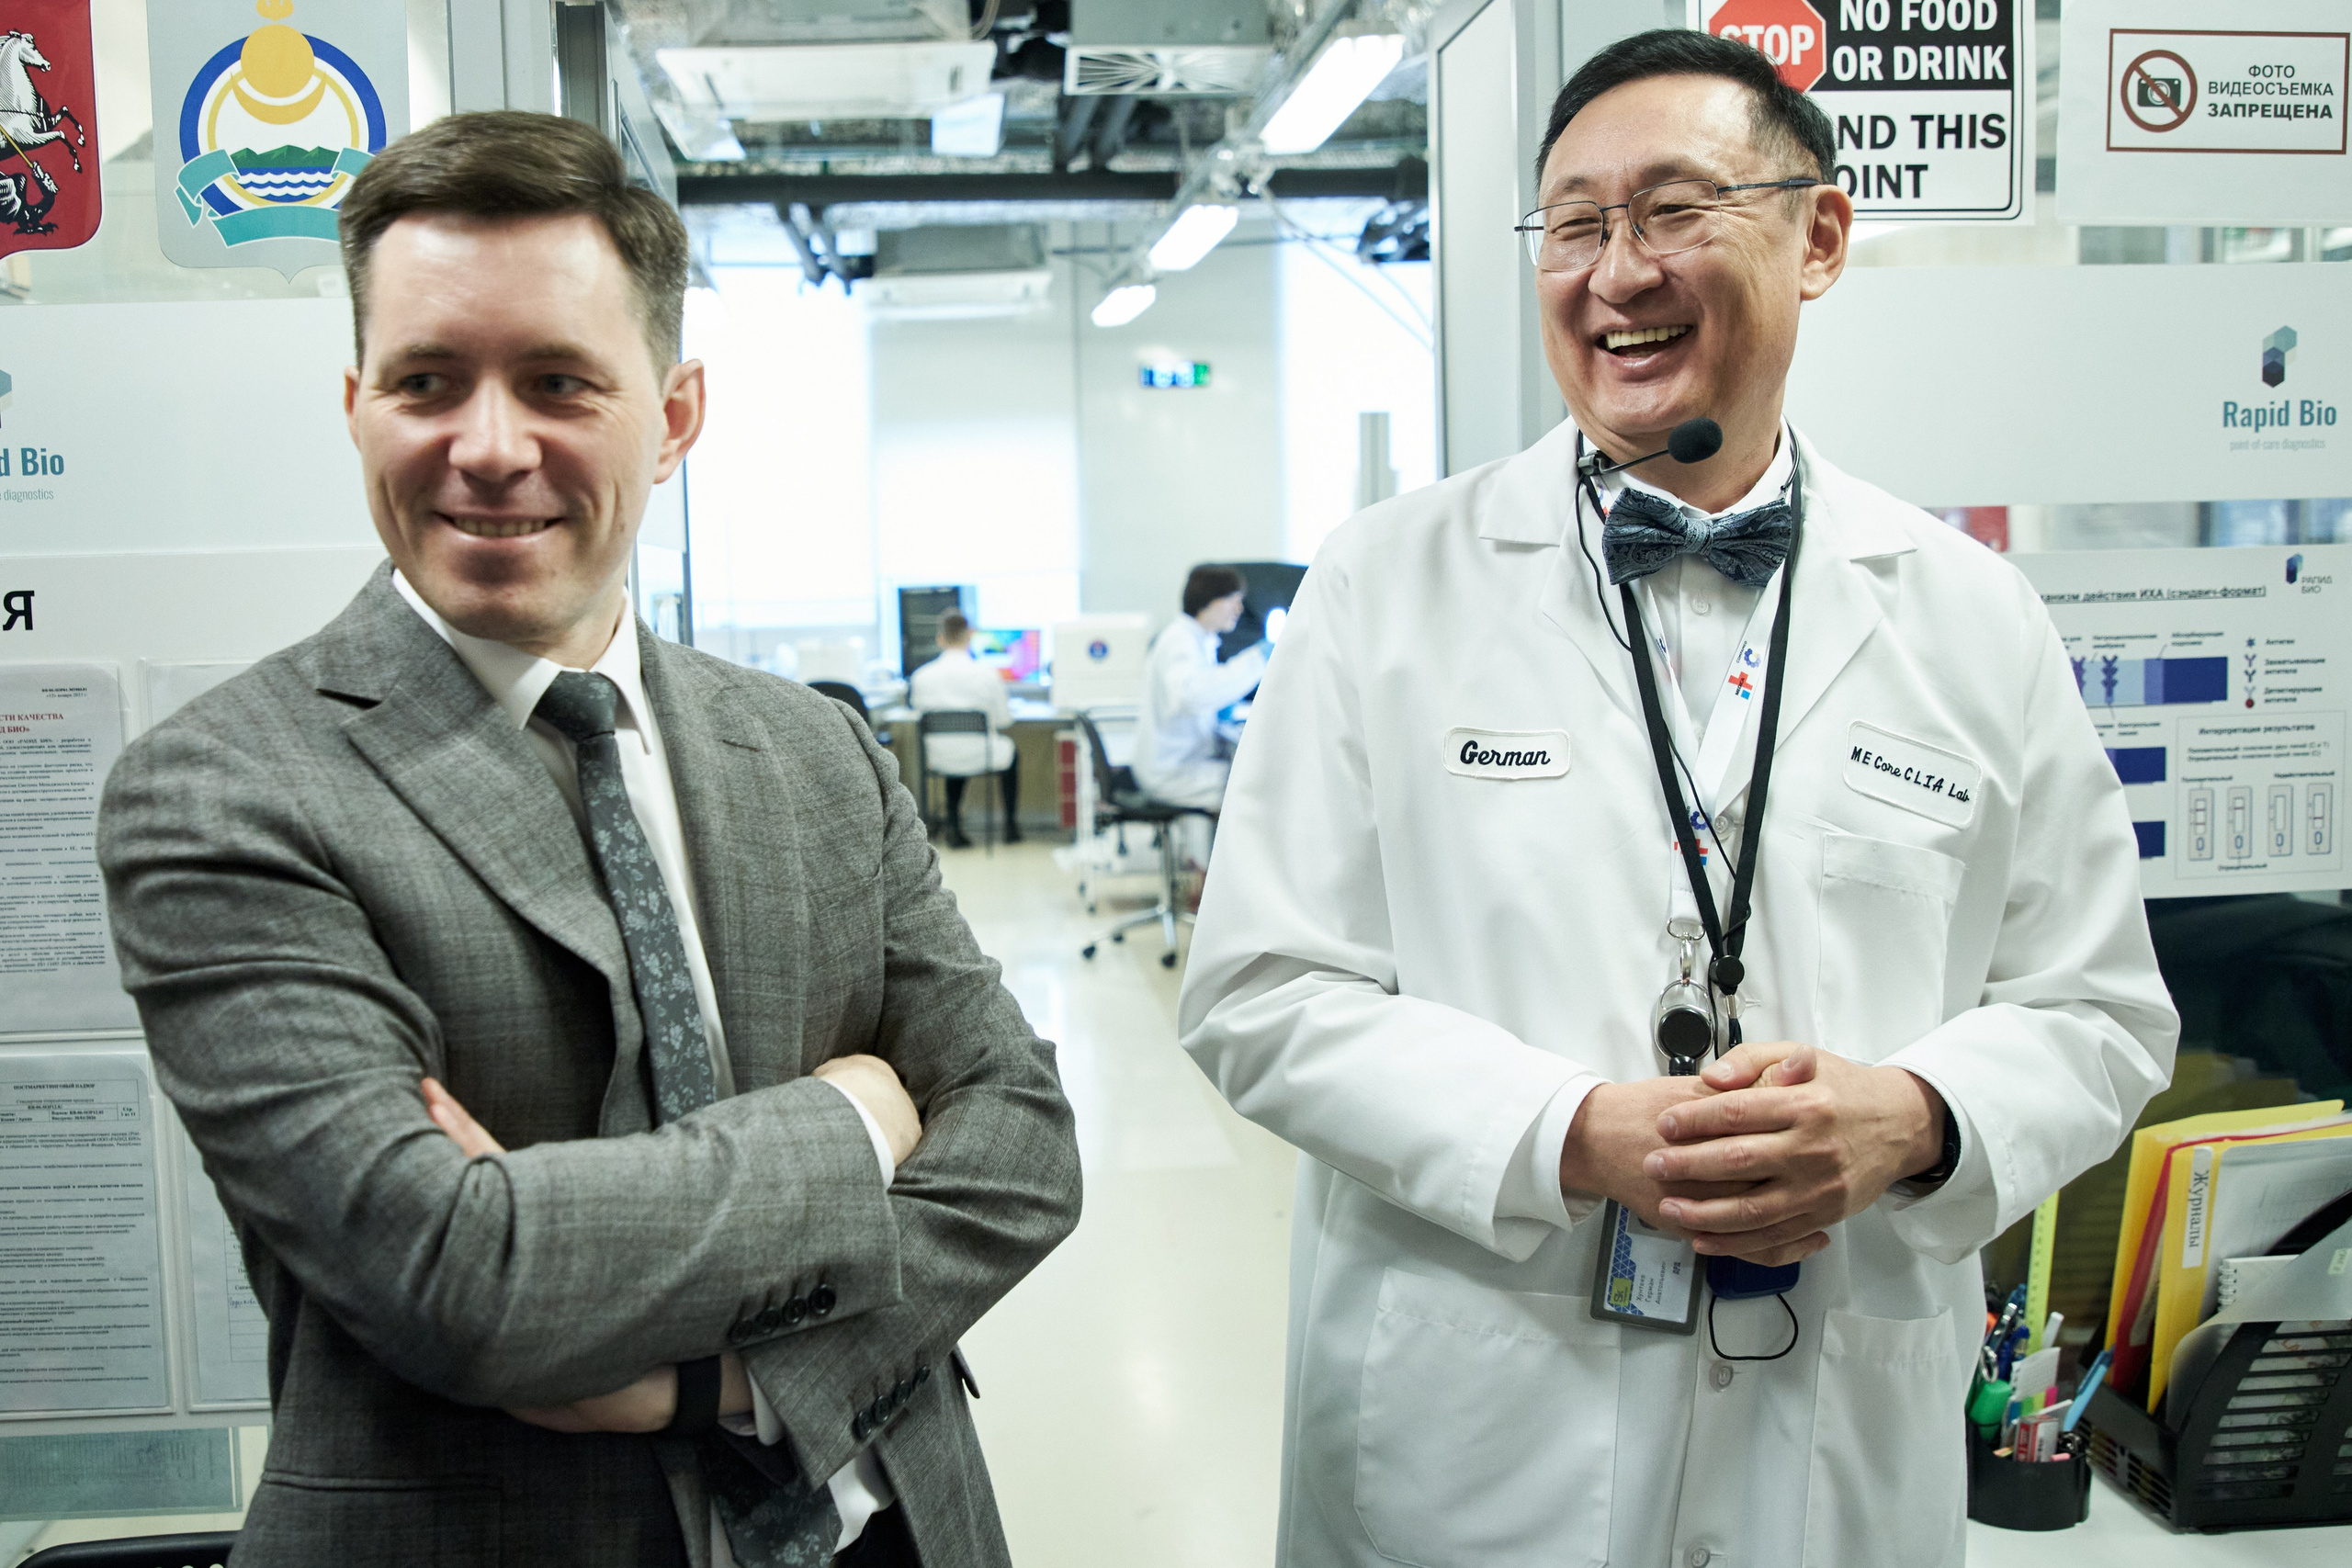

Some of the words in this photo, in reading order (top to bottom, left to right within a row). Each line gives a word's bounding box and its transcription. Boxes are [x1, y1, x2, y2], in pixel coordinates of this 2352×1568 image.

[1839, 0, 1890, 31] NO
[1901, 0, 1997, 31] FOOD
[1832, 46, 1883, 82] OR
[1894, 45, 2007, 81] DRINK
[2248, 65, 2295, 78] ФОТО
[2208, 81, 2334, 97] ВИДЕОСЪЕМКА
[2208, 103, 2333, 121] ЗАПРЕЩЕНА
[1911, 113, 2007, 150] THIS
[1836, 164, 1928, 199] OINT
[2222, 400, 2290, 433] Rapid
[2300, 400, 2337, 426] Bio
[21, 447, 64, 476] Bio
[4, 488, 54, 502] diagnostics
[2041, 593, 2079, 603] анизм
[1735, 678, 1745, 695] MEDICA
[17, 713, 64, 721] КАЧЕСТВА
[1460, 739, 1551, 766] German
[1874, 756, 1902, 777] Core
[1904, 767, 1945, 794] CLIA
[1948, 783, 1970, 802] Lab
[2188, 1170, 2210, 1247] Журналы
